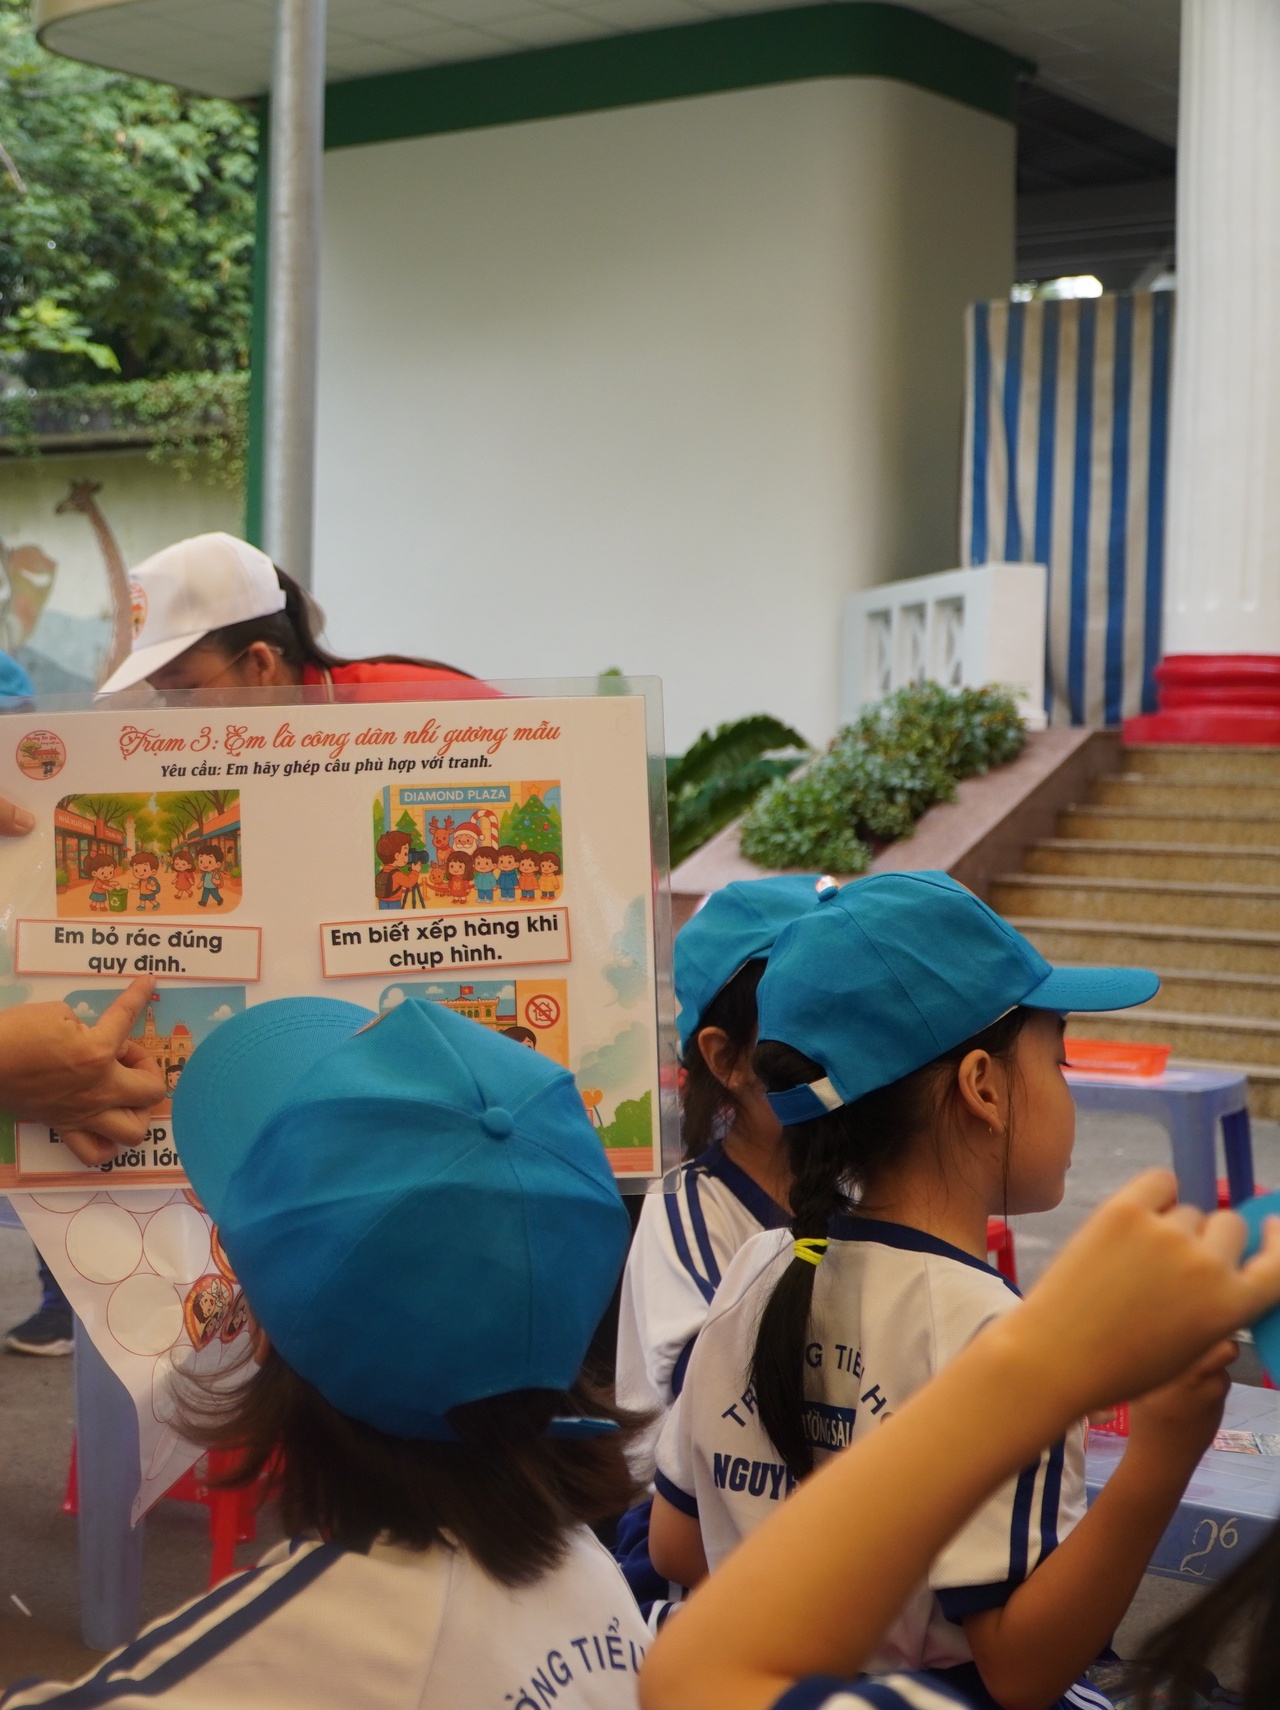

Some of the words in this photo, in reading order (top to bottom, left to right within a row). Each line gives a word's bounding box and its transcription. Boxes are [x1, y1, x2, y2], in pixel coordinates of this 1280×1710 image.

[119, 726, 186, 760] Trạm
[224, 724, 267, 757] Em
[272, 722, 297, 748] là
[301, 730, 350, 759] công
[354, 727, 397, 746] dân
[403, 718, 442, 745] nhí
[437, 724, 508, 756] gương
[513, 720, 561, 741] mẫu
[161, 764, 186, 777] Yêu
[191, 760, 222, 777] cầu:
[226, 763, 248, 775] Em
[253, 761, 280, 777] hãy
[283, 760, 320, 777] ghép
[324, 758, 350, 772] câu
[355, 758, 383, 774] phù
[388, 757, 416, 774] hợp
[421, 756, 443, 769] với
[448, 755, 492, 769] tranh.
[404, 791, 464, 802] DIAMOND
[468, 789, 506, 800] PLAZA
[54, 927, 84, 944] Em
[91, 926, 119, 945] bỏ
[126, 928, 161, 947] rác
[168, 930, 223, 953] đúng
[331, 929, 362, 946] Em
[369, 921, 410, 943] biết
[416, 918, 457, 941] xếp
[464, 918, 520, 939] hàng
[527, 914, 559, 933] khi
[88, 956, 128, 974] quy
[134, 955, 186, 975] định.
[389, 949, 444, 970] chụp
[451, 944, 502, 963] hình.
[87, 1149, 146, 1172] gười
[1179, 1517, 1240, 1576] 26
